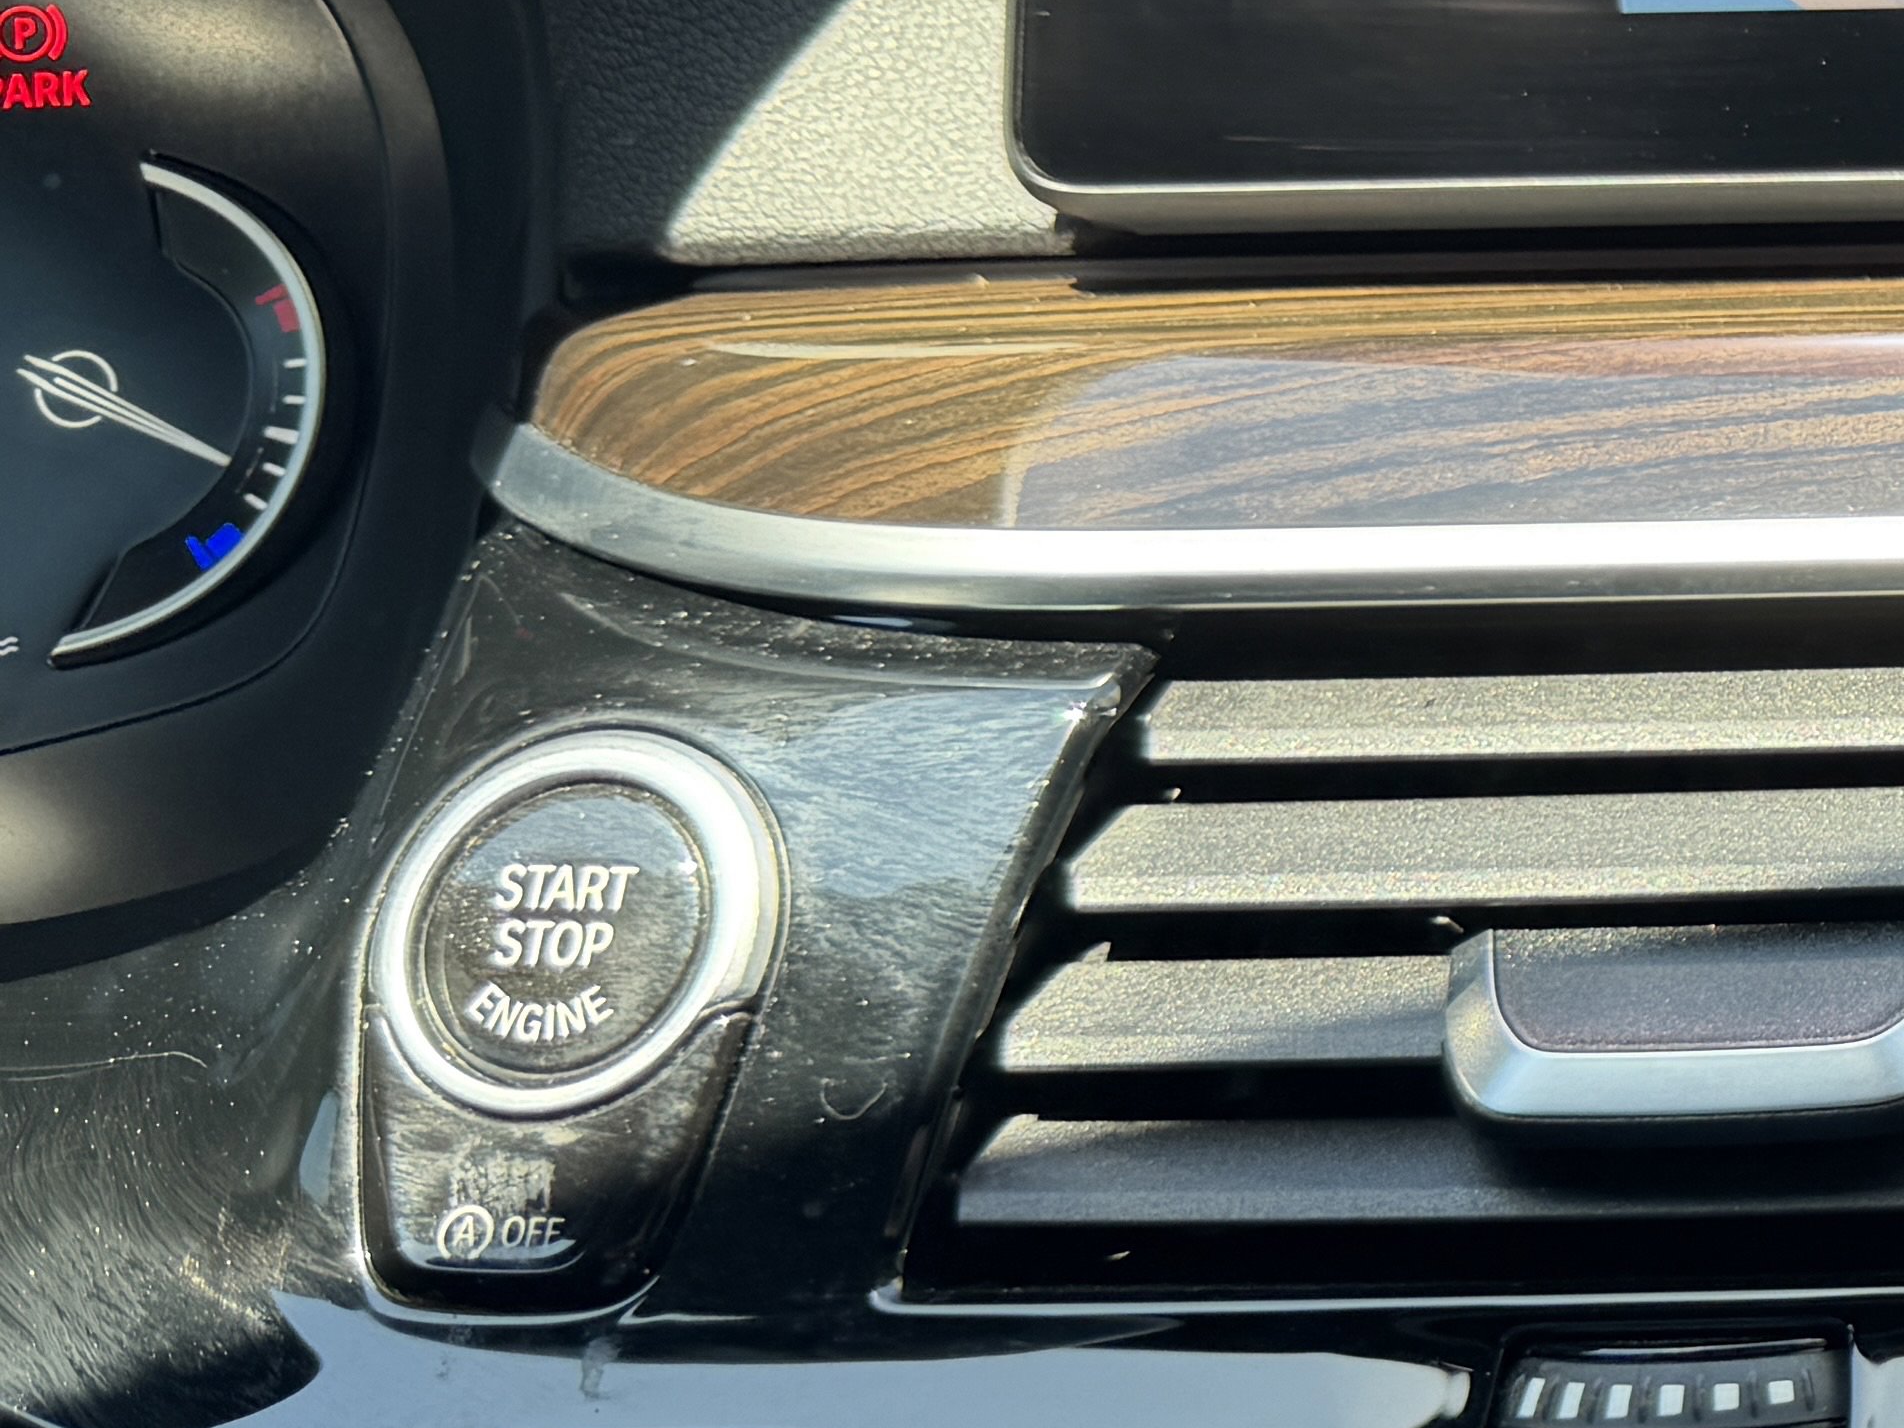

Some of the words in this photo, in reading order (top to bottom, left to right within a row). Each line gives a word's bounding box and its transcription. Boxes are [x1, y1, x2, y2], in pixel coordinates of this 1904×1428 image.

[0, 69, 92, 110] ARK
[494, 863, 640, 914] START
[494, 919, 615, 968] STOP
[466, 982, 615, 1043] ENGINE
[502, 1214, 567, 1249] OFF
